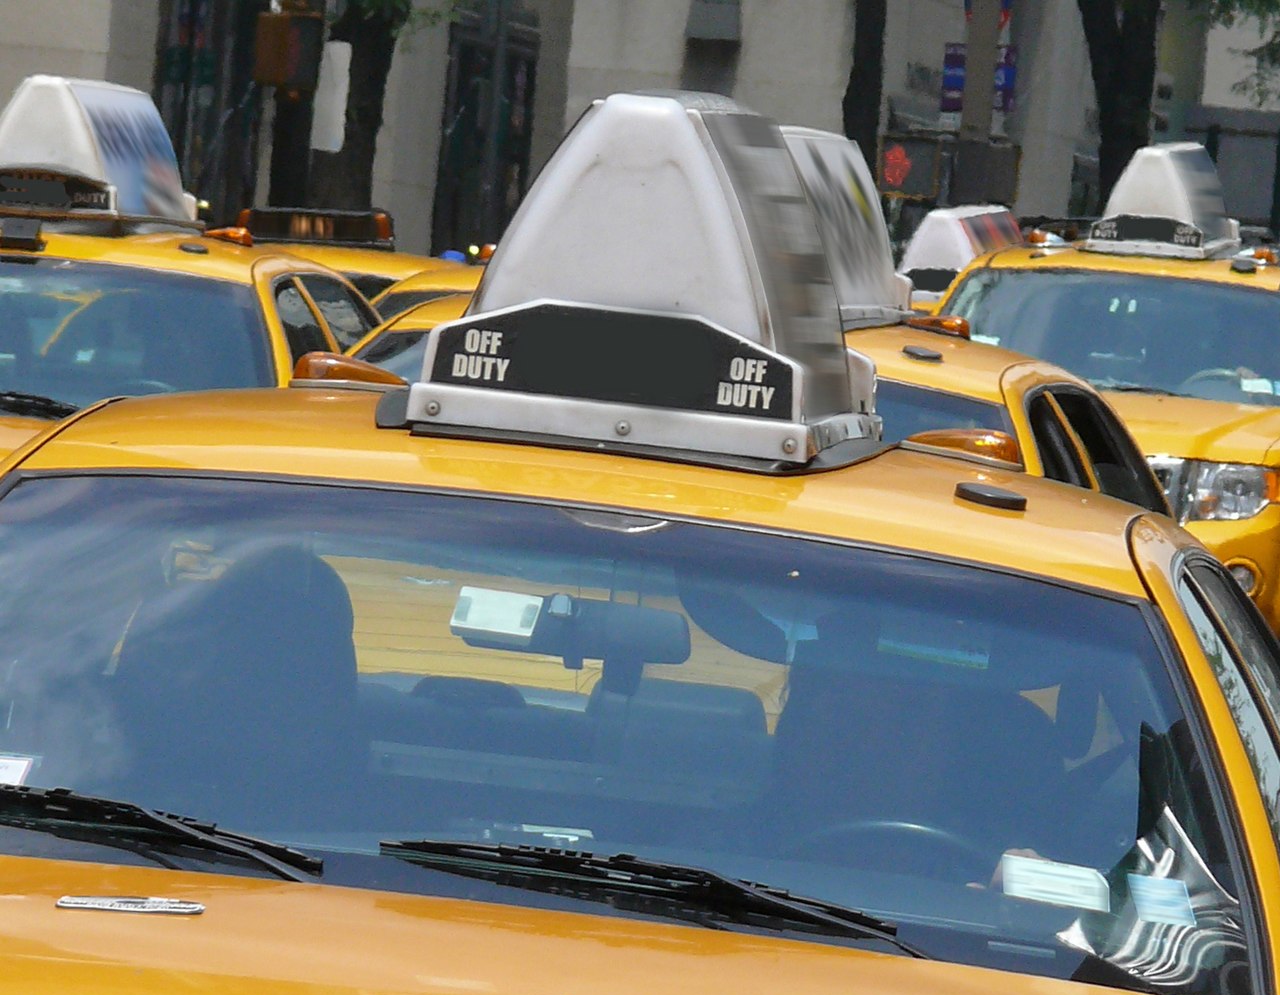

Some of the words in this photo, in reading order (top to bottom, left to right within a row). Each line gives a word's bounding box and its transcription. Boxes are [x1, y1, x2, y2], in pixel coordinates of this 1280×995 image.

[465, 328, 503, 355] OFF
[451, 353, 511, 382] DUTY
[730, 357, 768, 383] OFF
[717, 381, 775, 410] DUTY
